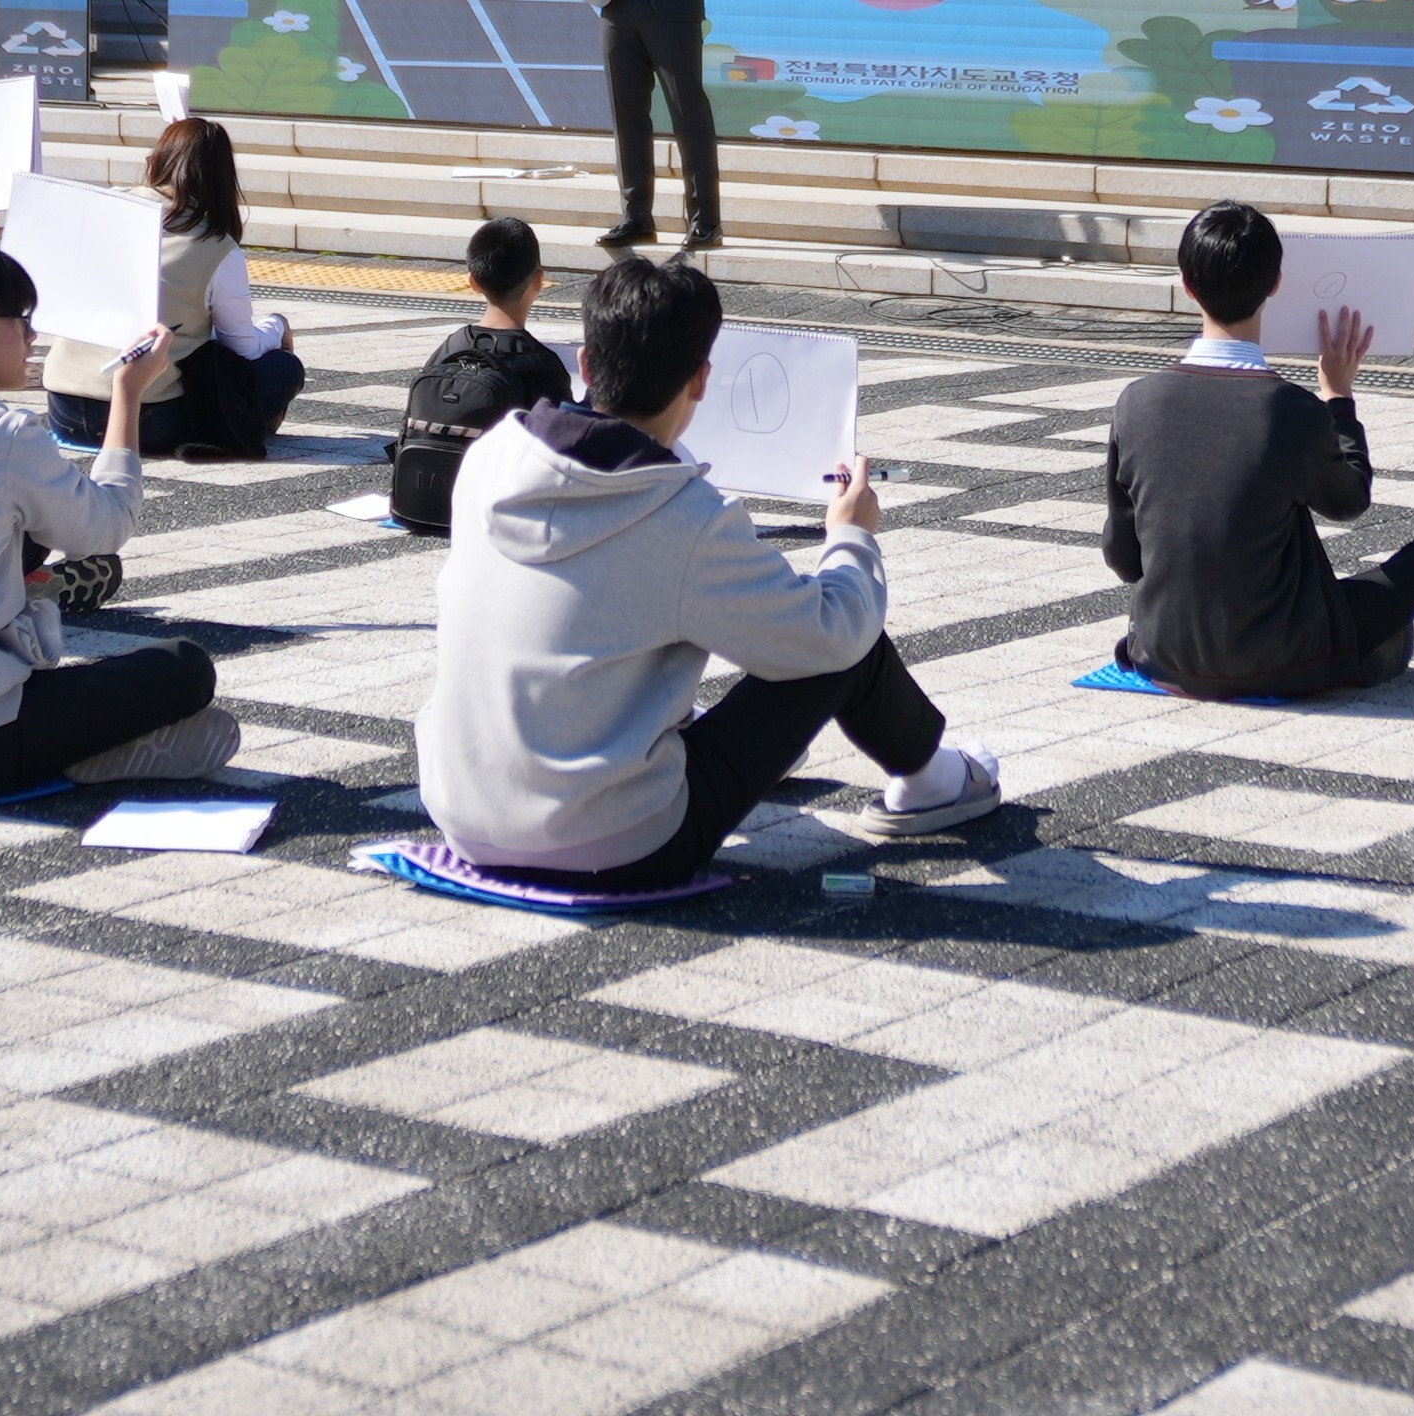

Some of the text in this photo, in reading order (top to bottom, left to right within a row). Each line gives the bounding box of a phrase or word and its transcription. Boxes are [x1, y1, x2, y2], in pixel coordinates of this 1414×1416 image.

[12, 64, 74, 75] ZERO
[784, 60, 1080, 86] 전북특별자치도교육청
[784, 75, 1080, 95] JEONBUK STATE OFFICE OF EDUCATION
[1320, 121, 1401, 134] ZERO
[1310, 132, 1413, 146] WASTE
